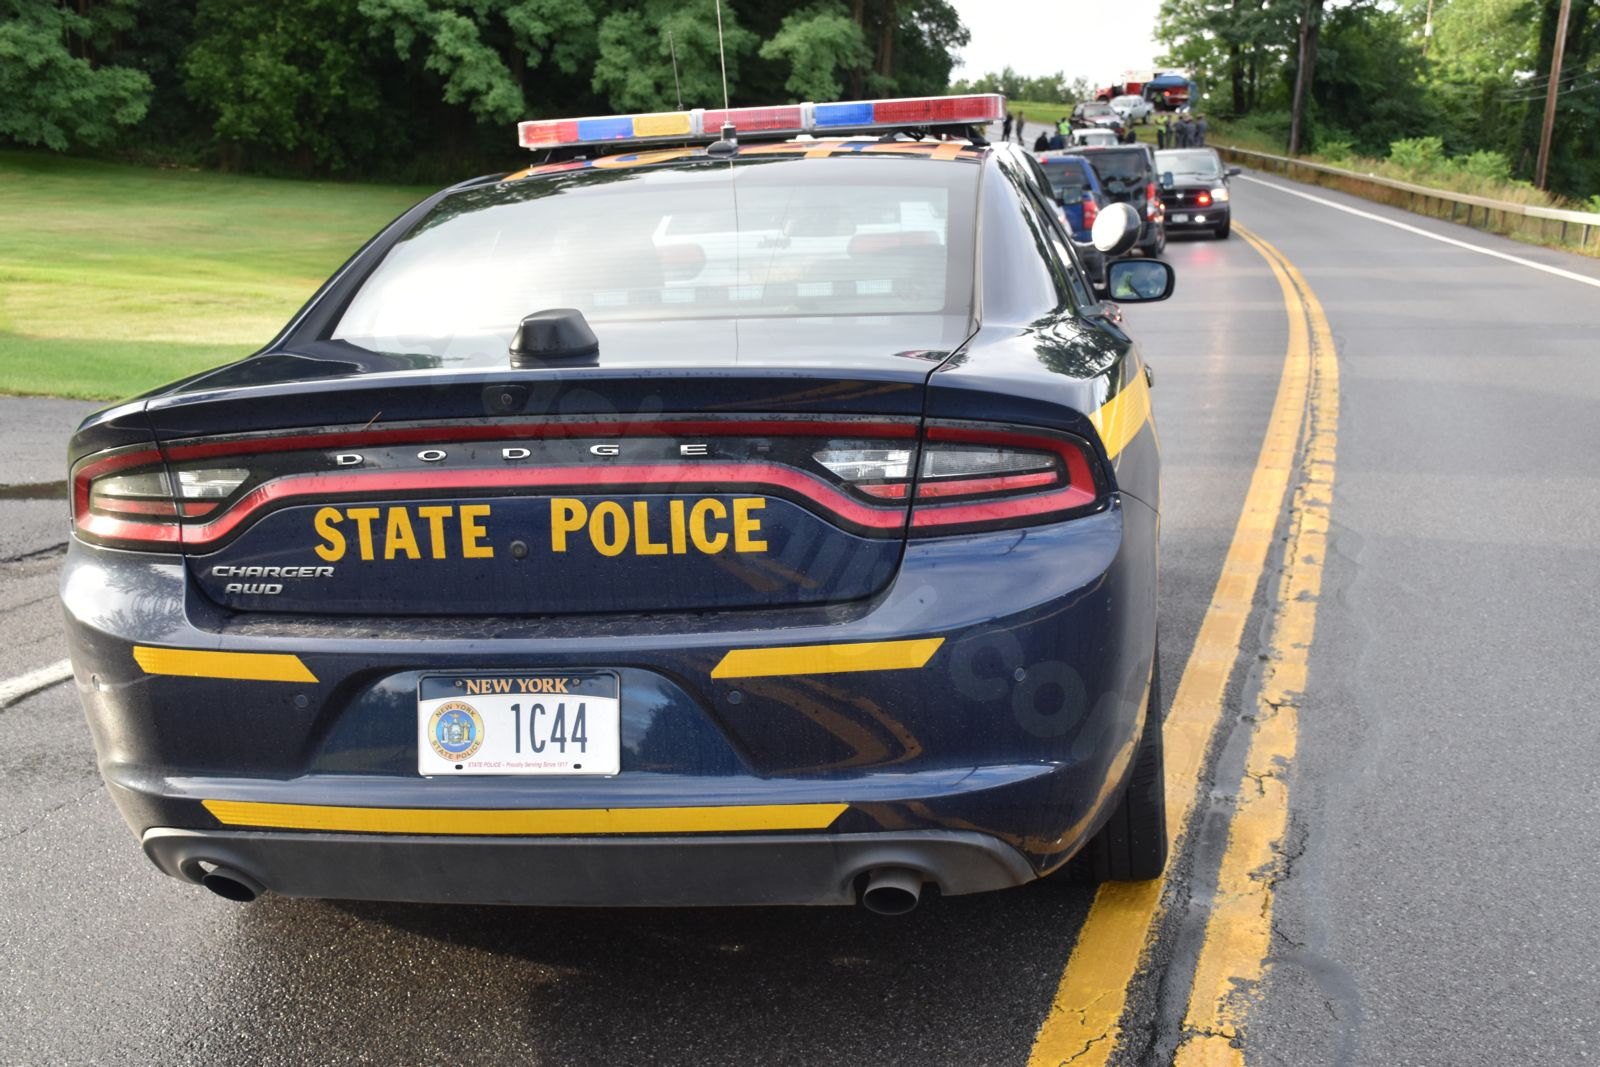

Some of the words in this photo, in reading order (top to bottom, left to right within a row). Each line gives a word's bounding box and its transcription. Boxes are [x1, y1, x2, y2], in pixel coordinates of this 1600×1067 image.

[336, 443, 709, 466] DODGE
[314, 504, 495, 562] STATE
[551, 497, 769, 557] POLICE
[211, 565, 335, 579] CHARGER
[224, 583, 284, 595] AWD
[466, 679, 513, 695] NEW
[517, 678, 569, 694] YORK
[435, 704, 453, 718] NEW
[455, 704, 477, 718] YORK
[510, 702, 588, 754] 1C44
[432, 740, 453, 760] STATE
[455, 740, 481, 760] POLICE
